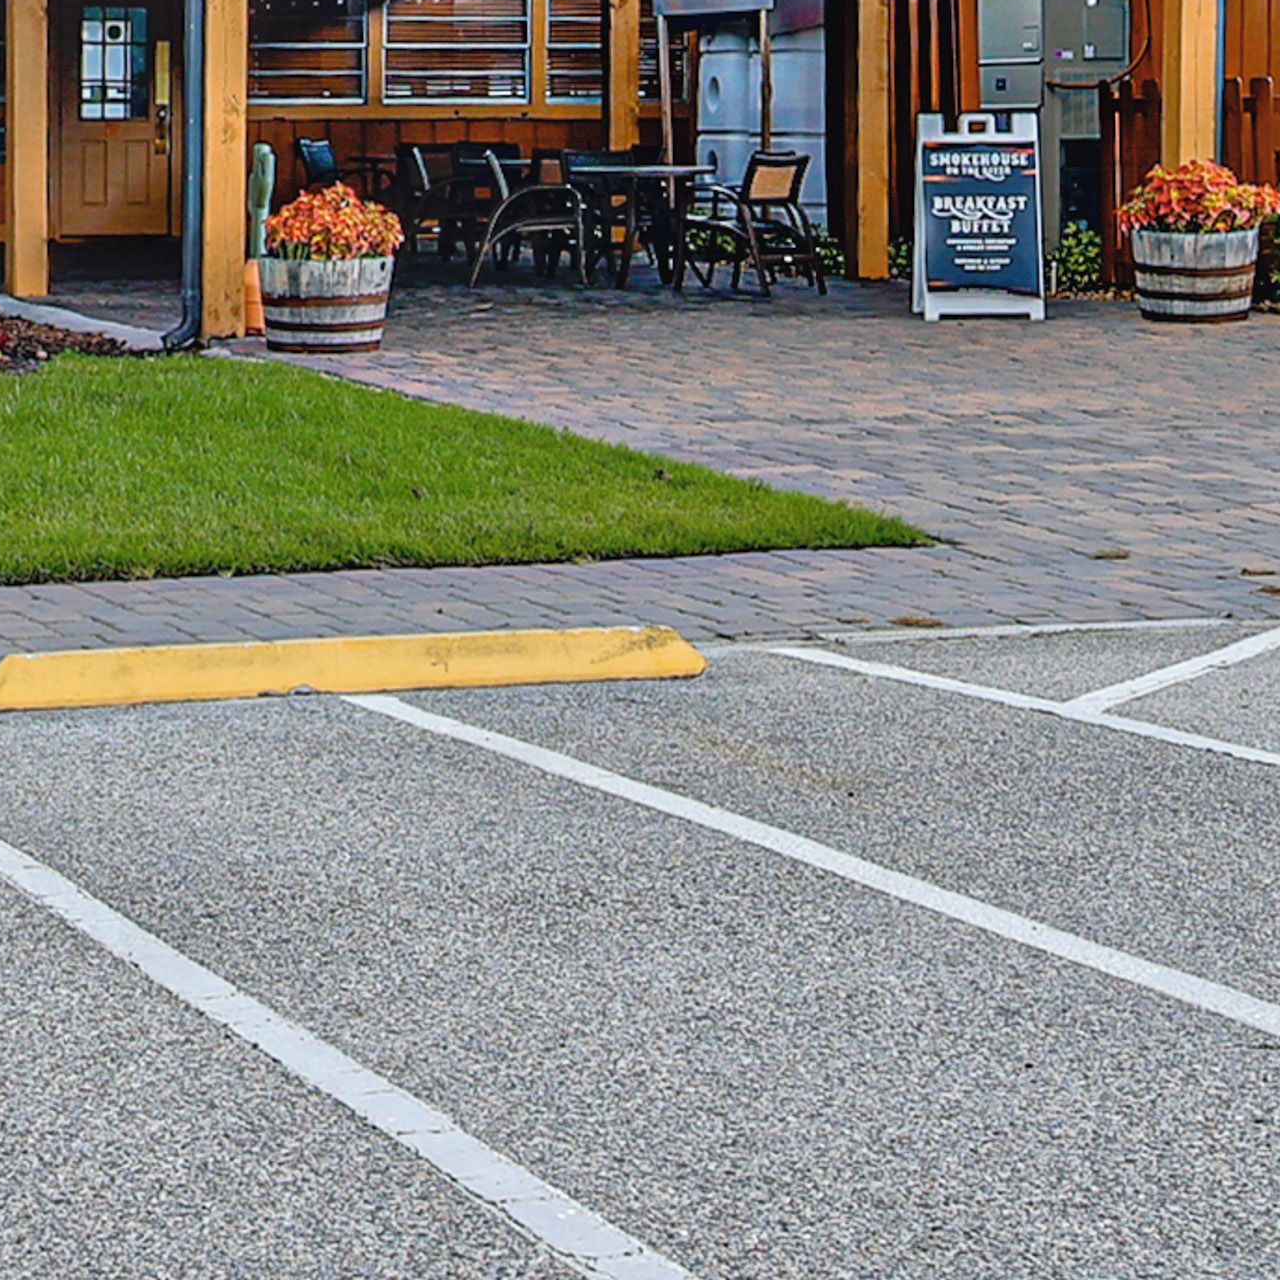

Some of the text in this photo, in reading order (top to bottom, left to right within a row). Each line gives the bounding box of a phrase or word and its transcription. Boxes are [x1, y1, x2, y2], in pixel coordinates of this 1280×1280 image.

[930, 152, 1028, 166] SMOKEHOUSE
[933, 196, 1027, 219] BREAKFAST
[951, 219, 1010, 233] BUFFET
